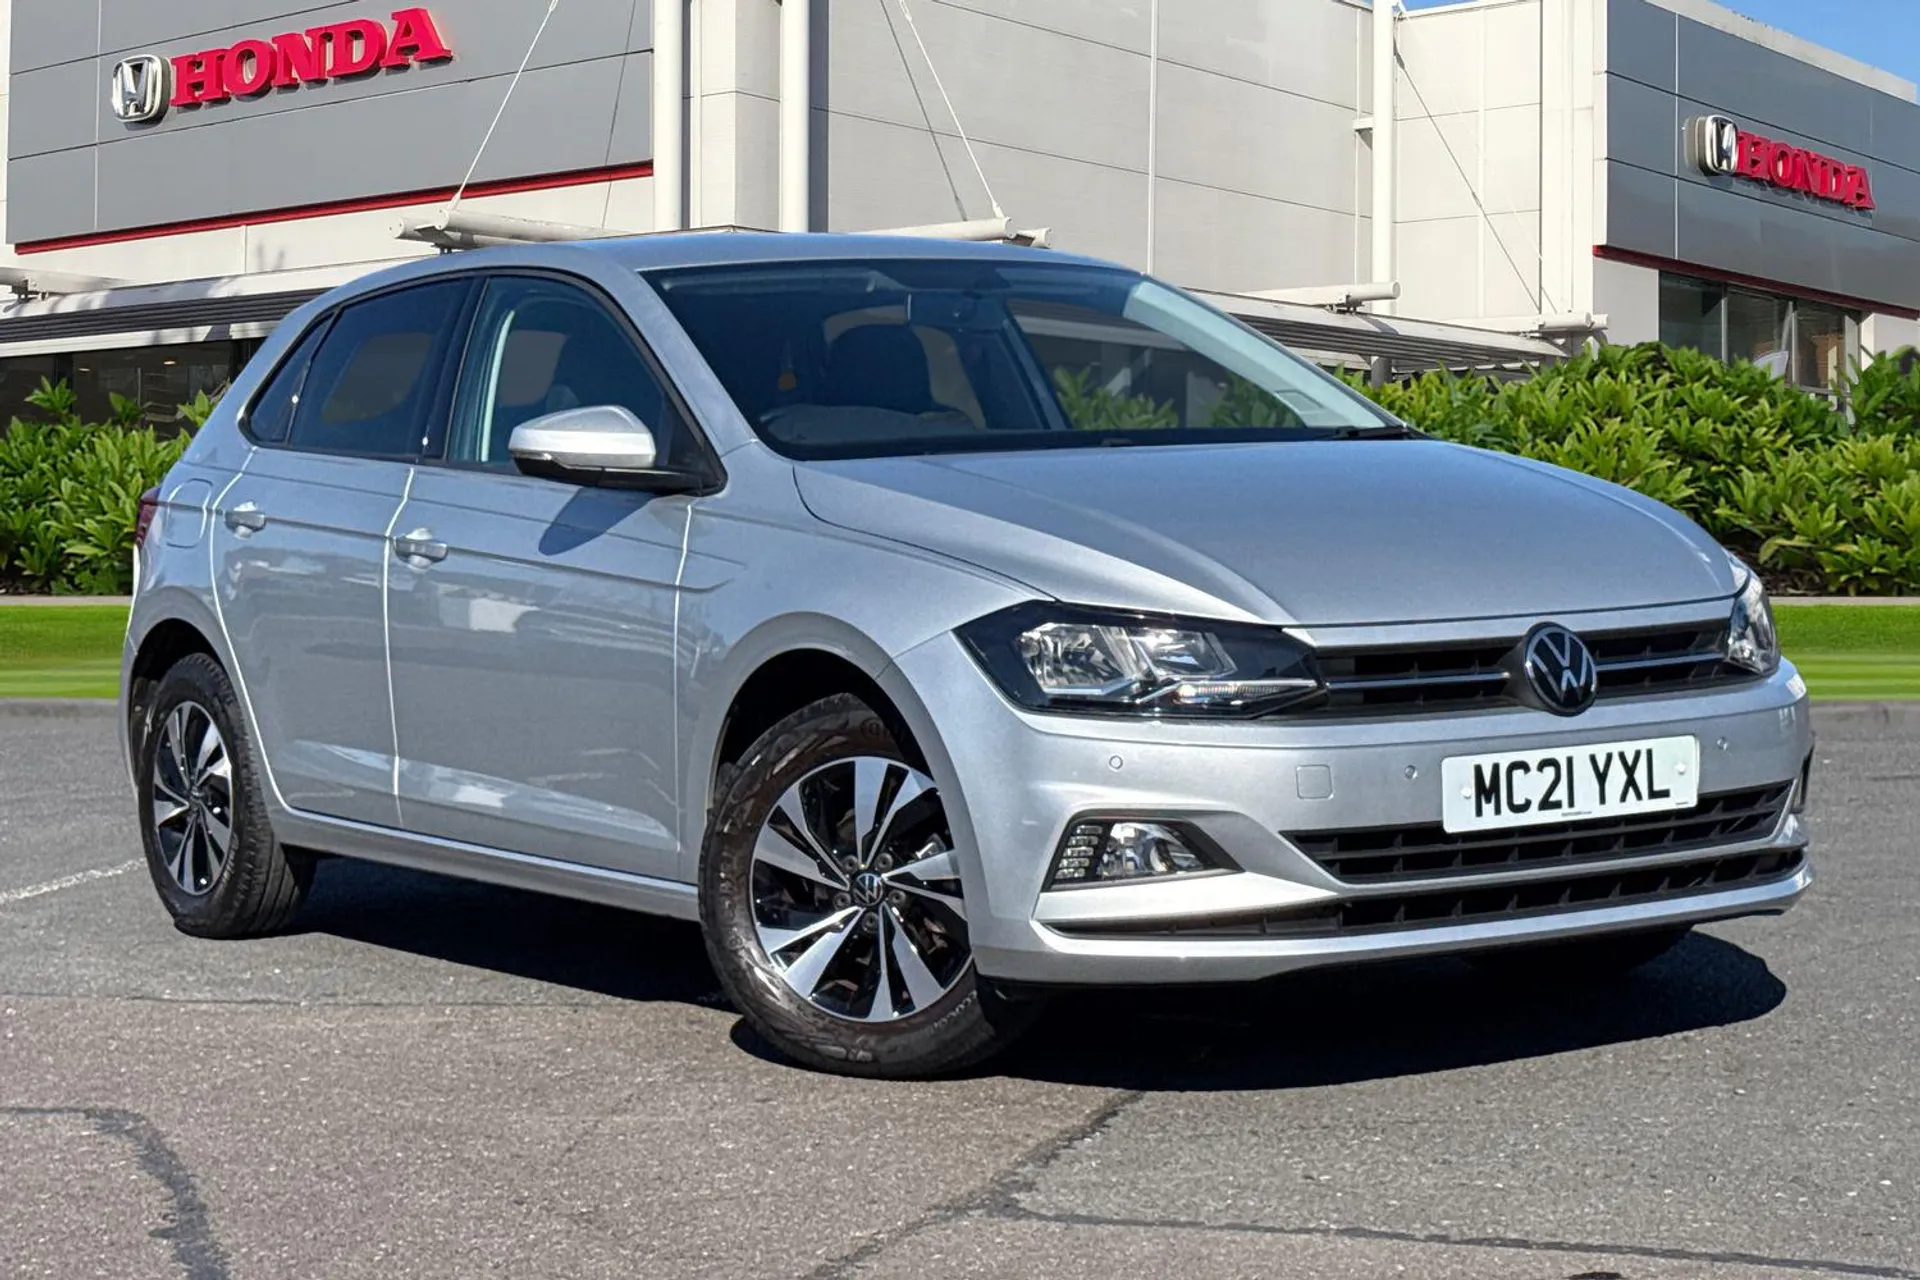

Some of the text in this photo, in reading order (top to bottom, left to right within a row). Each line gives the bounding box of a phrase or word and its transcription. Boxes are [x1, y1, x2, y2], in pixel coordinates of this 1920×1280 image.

[170, 7, 453, 108] HONDA
[1736, 130, 1876, 210] HONDA
[1473, 748, 1671, 818] MC21 YXL
